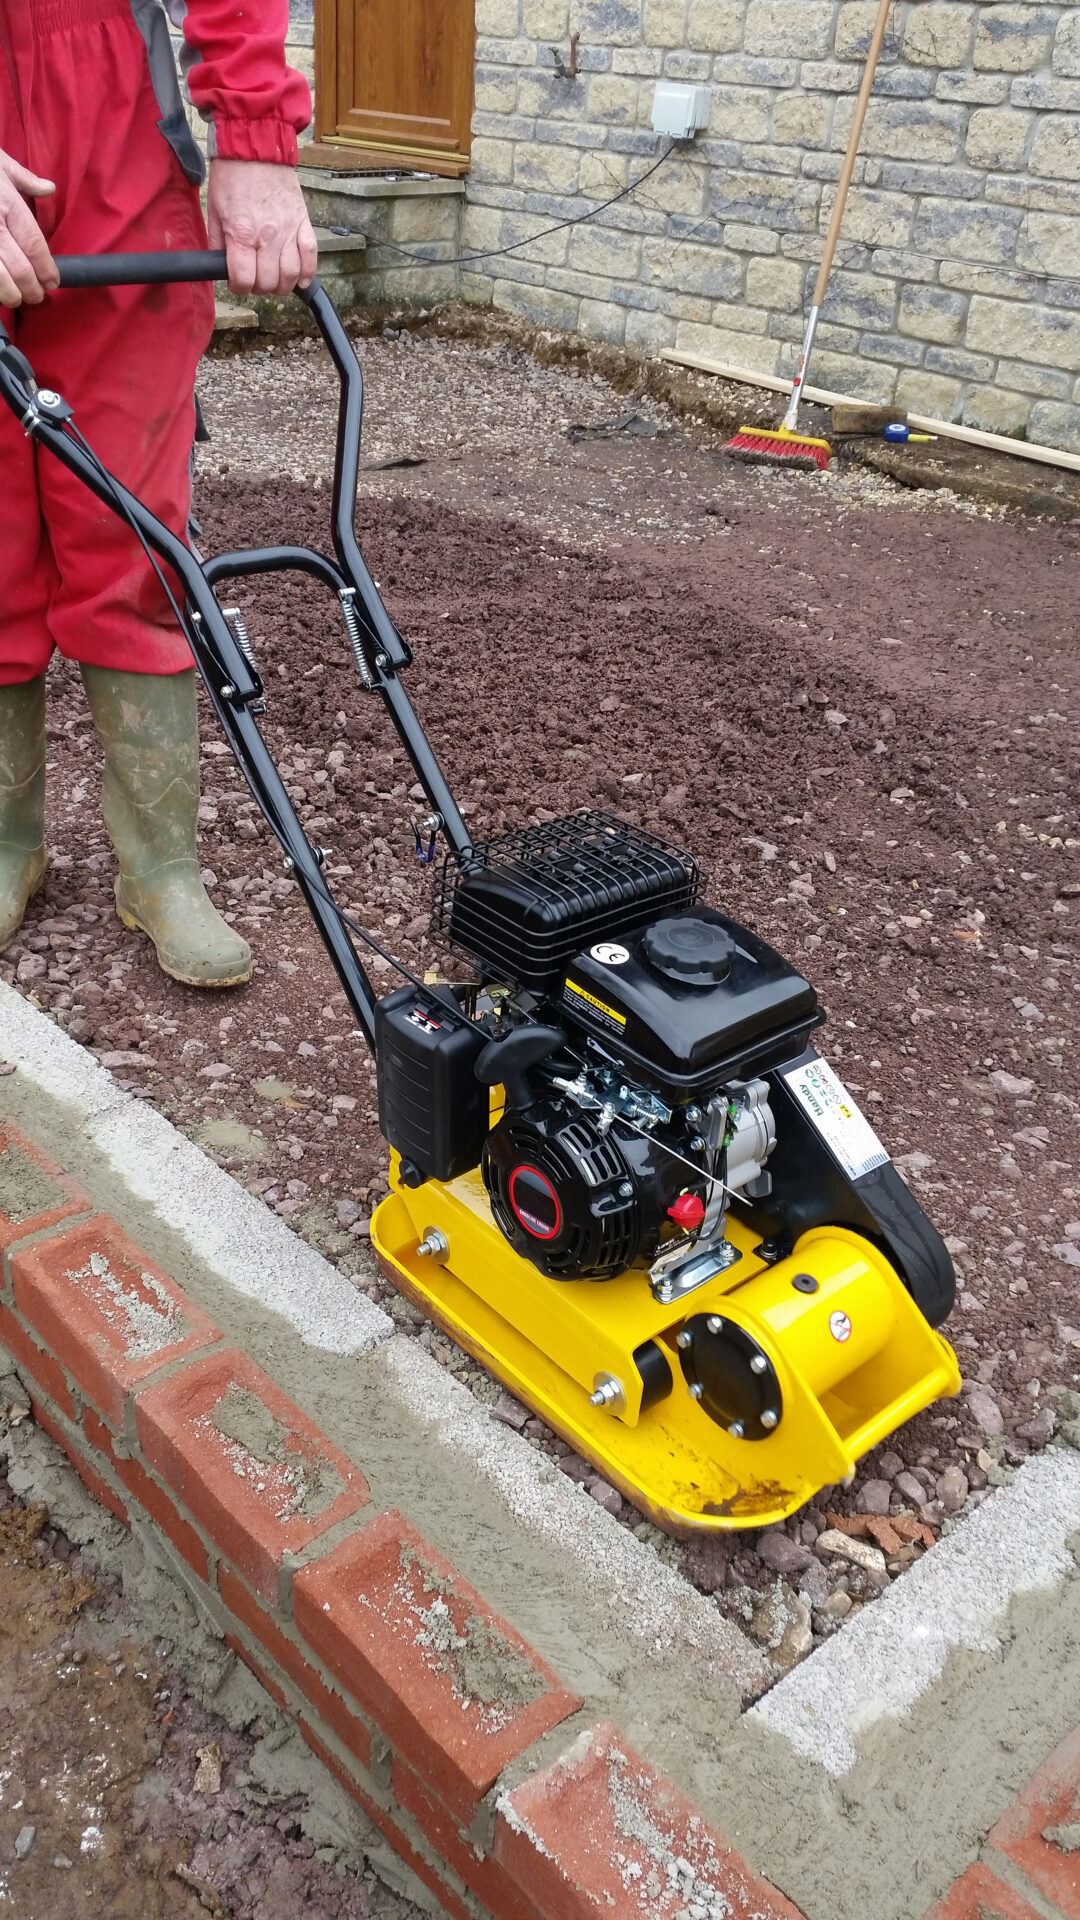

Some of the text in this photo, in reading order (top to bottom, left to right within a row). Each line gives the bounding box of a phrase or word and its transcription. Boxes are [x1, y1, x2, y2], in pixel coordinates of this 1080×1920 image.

[596, 945, 626, 963] CE
[585, 993, 611, 1014] CAUTION
[799, 1083, 825, 1117] Handy
